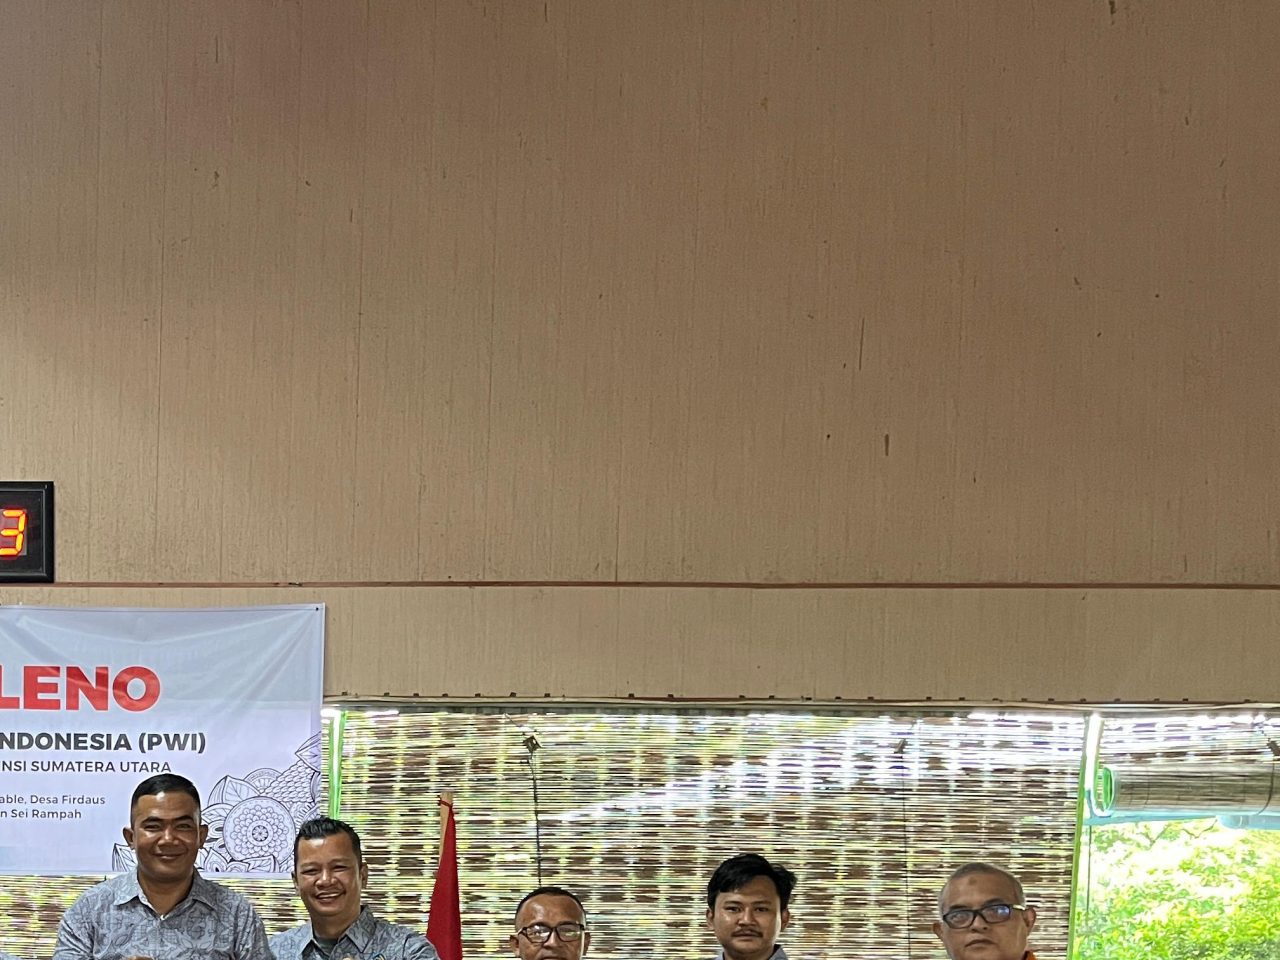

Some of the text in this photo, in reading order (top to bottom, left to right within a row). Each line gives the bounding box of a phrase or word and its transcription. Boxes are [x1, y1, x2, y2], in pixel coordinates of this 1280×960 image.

[138, 732, 206, 754] (PWI)
[30, 760, 116, 773] SUMATERA
[120, 761, 172, 773] UTARA
[30, 794, 58, 805] Desa
[61, 794, 106, 805] Firdaus
[11, 808, 28, 818] Sei
[31, 809, 82, 821] Rampah
